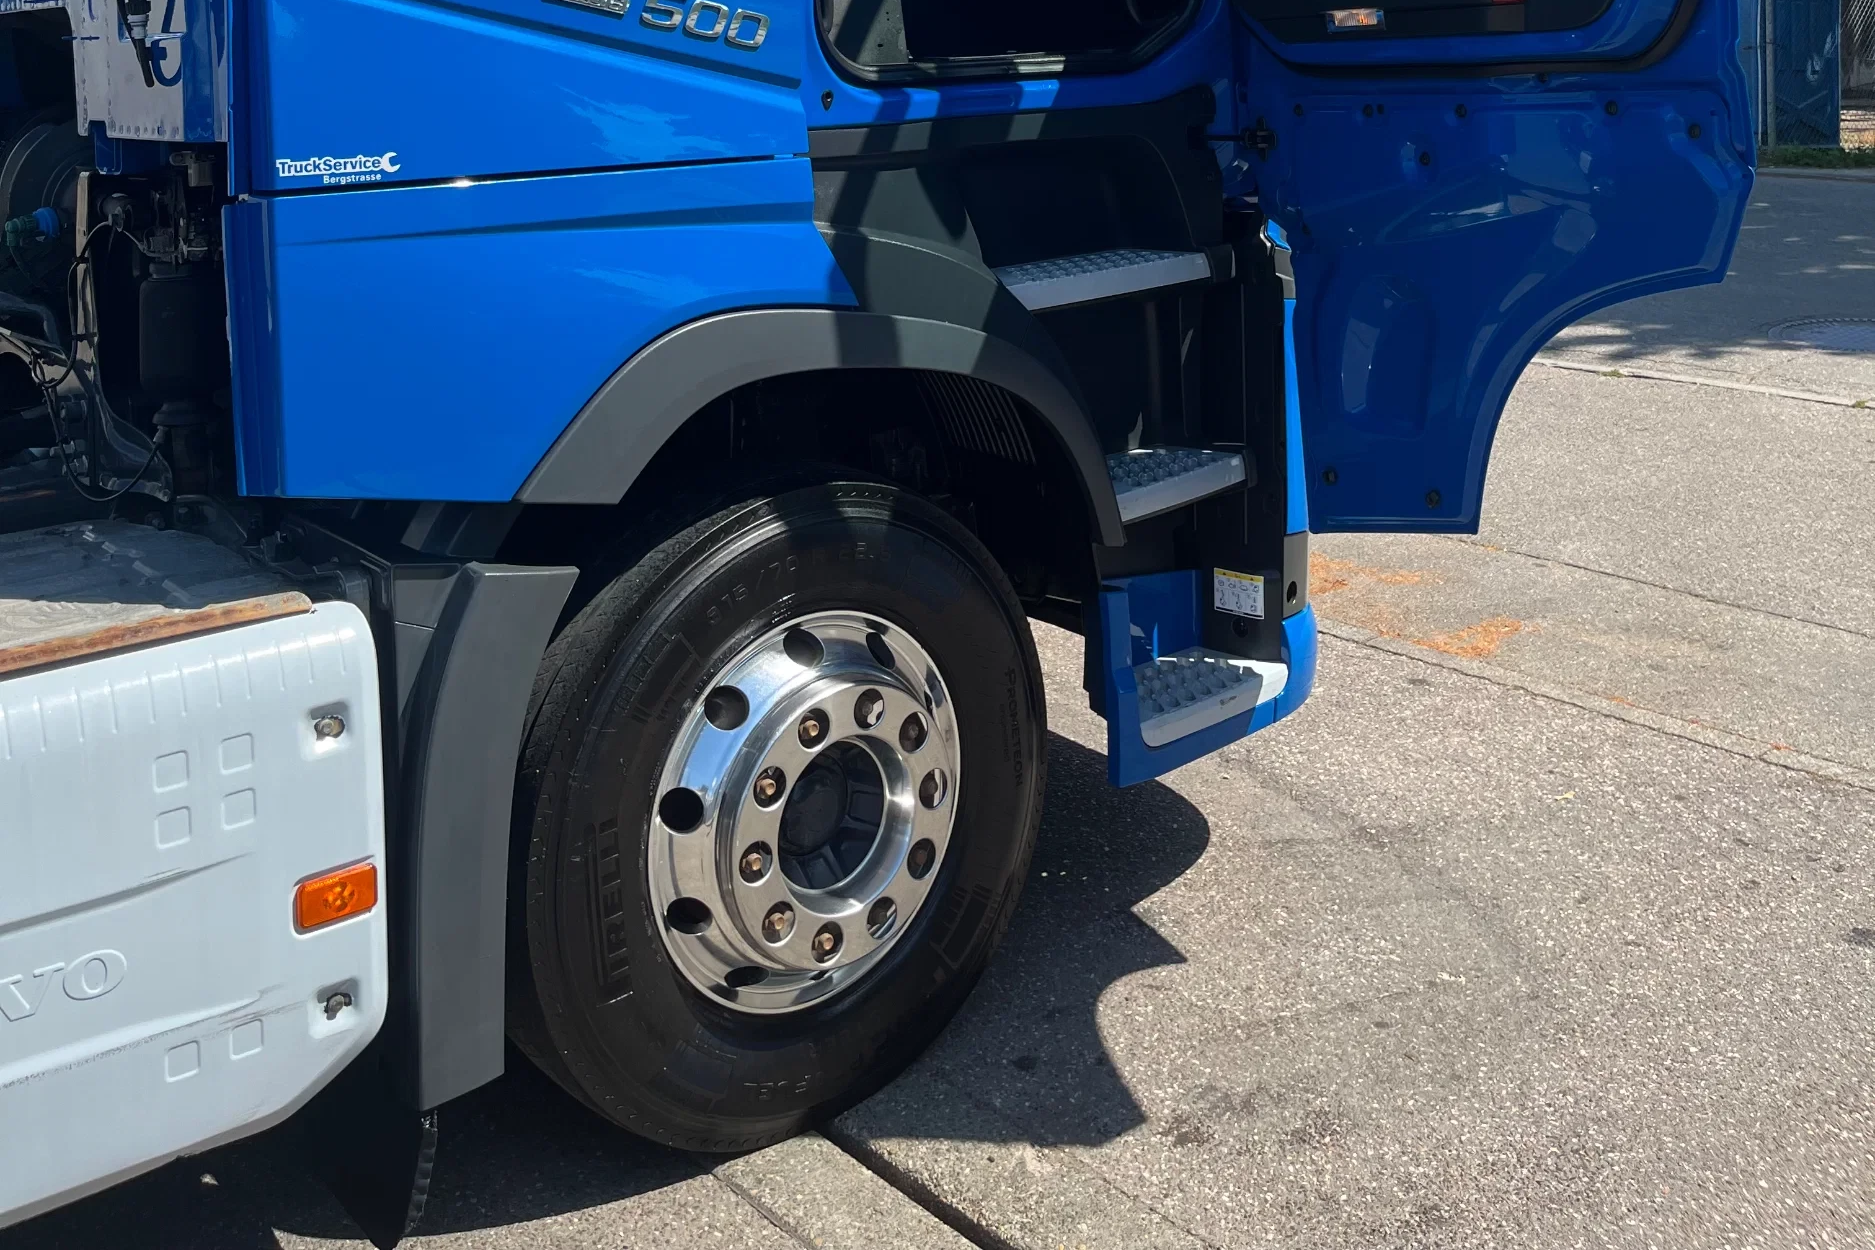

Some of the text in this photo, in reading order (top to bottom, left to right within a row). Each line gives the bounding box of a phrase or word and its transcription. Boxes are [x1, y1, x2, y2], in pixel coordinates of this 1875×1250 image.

[277, 154, 382, 176] TruckService
[323, 172, 382, 185] Bergstrasse
[1004, 666, 1024, 787] PROMETEON
[583, 813, 634, 1009] PIRELLI
